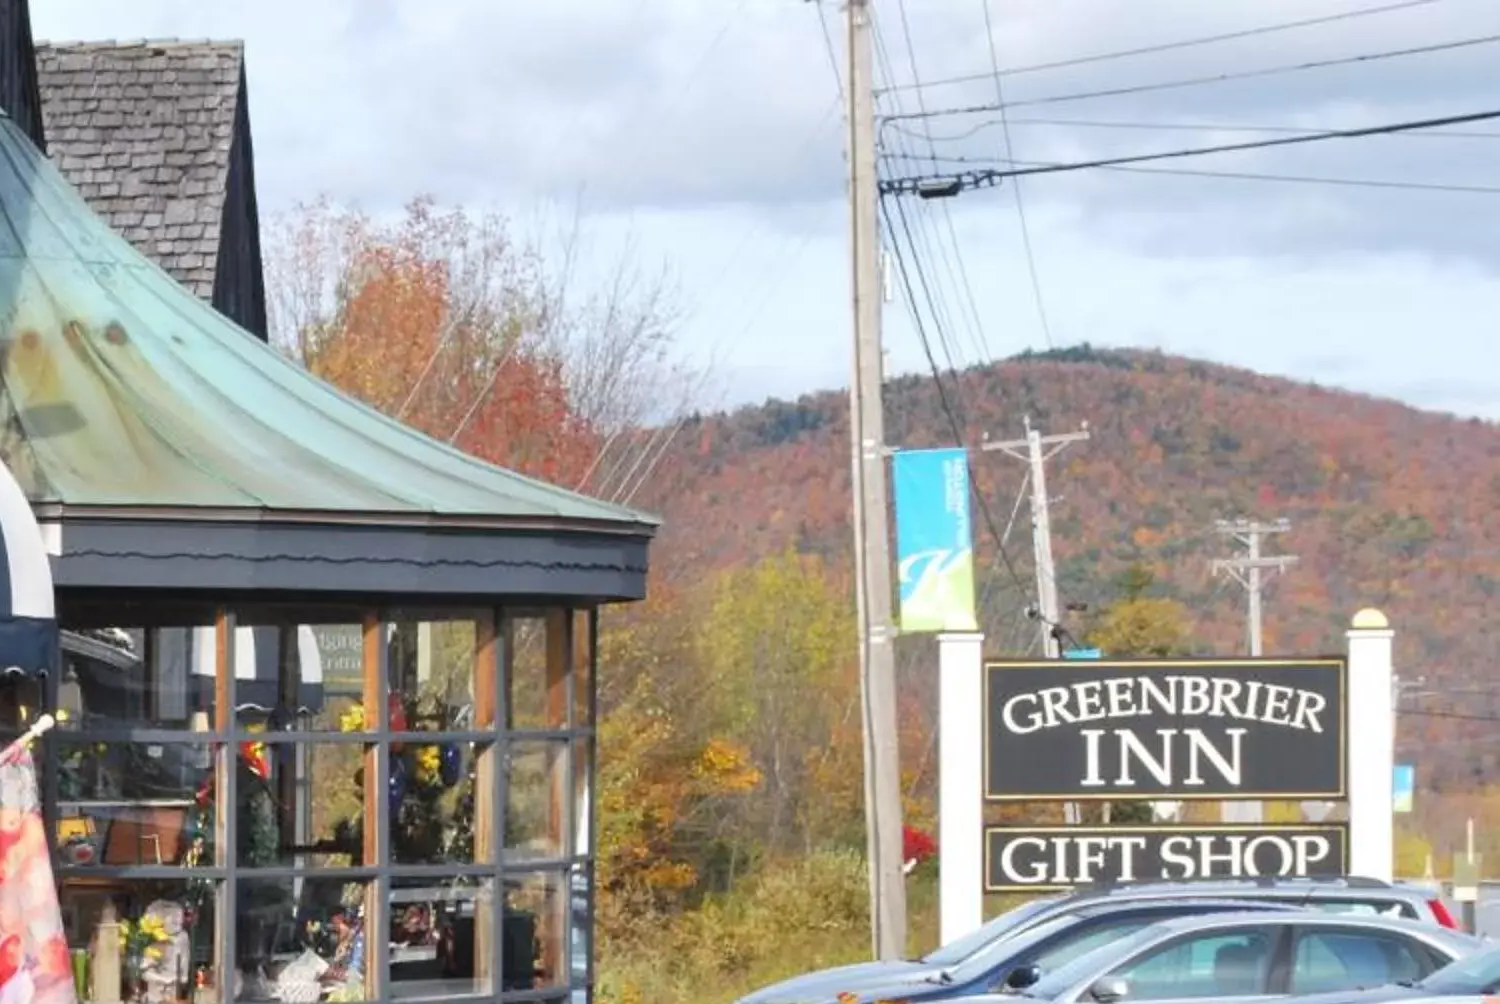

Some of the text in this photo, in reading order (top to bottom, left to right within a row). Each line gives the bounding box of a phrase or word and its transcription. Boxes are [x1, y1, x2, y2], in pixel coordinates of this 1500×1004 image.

[1002, 675, 1327, 735] GREENBRIER
[1080, 727, 1249, 787] INN
[1001, 835, 1331, 884] GIFT SHOP
